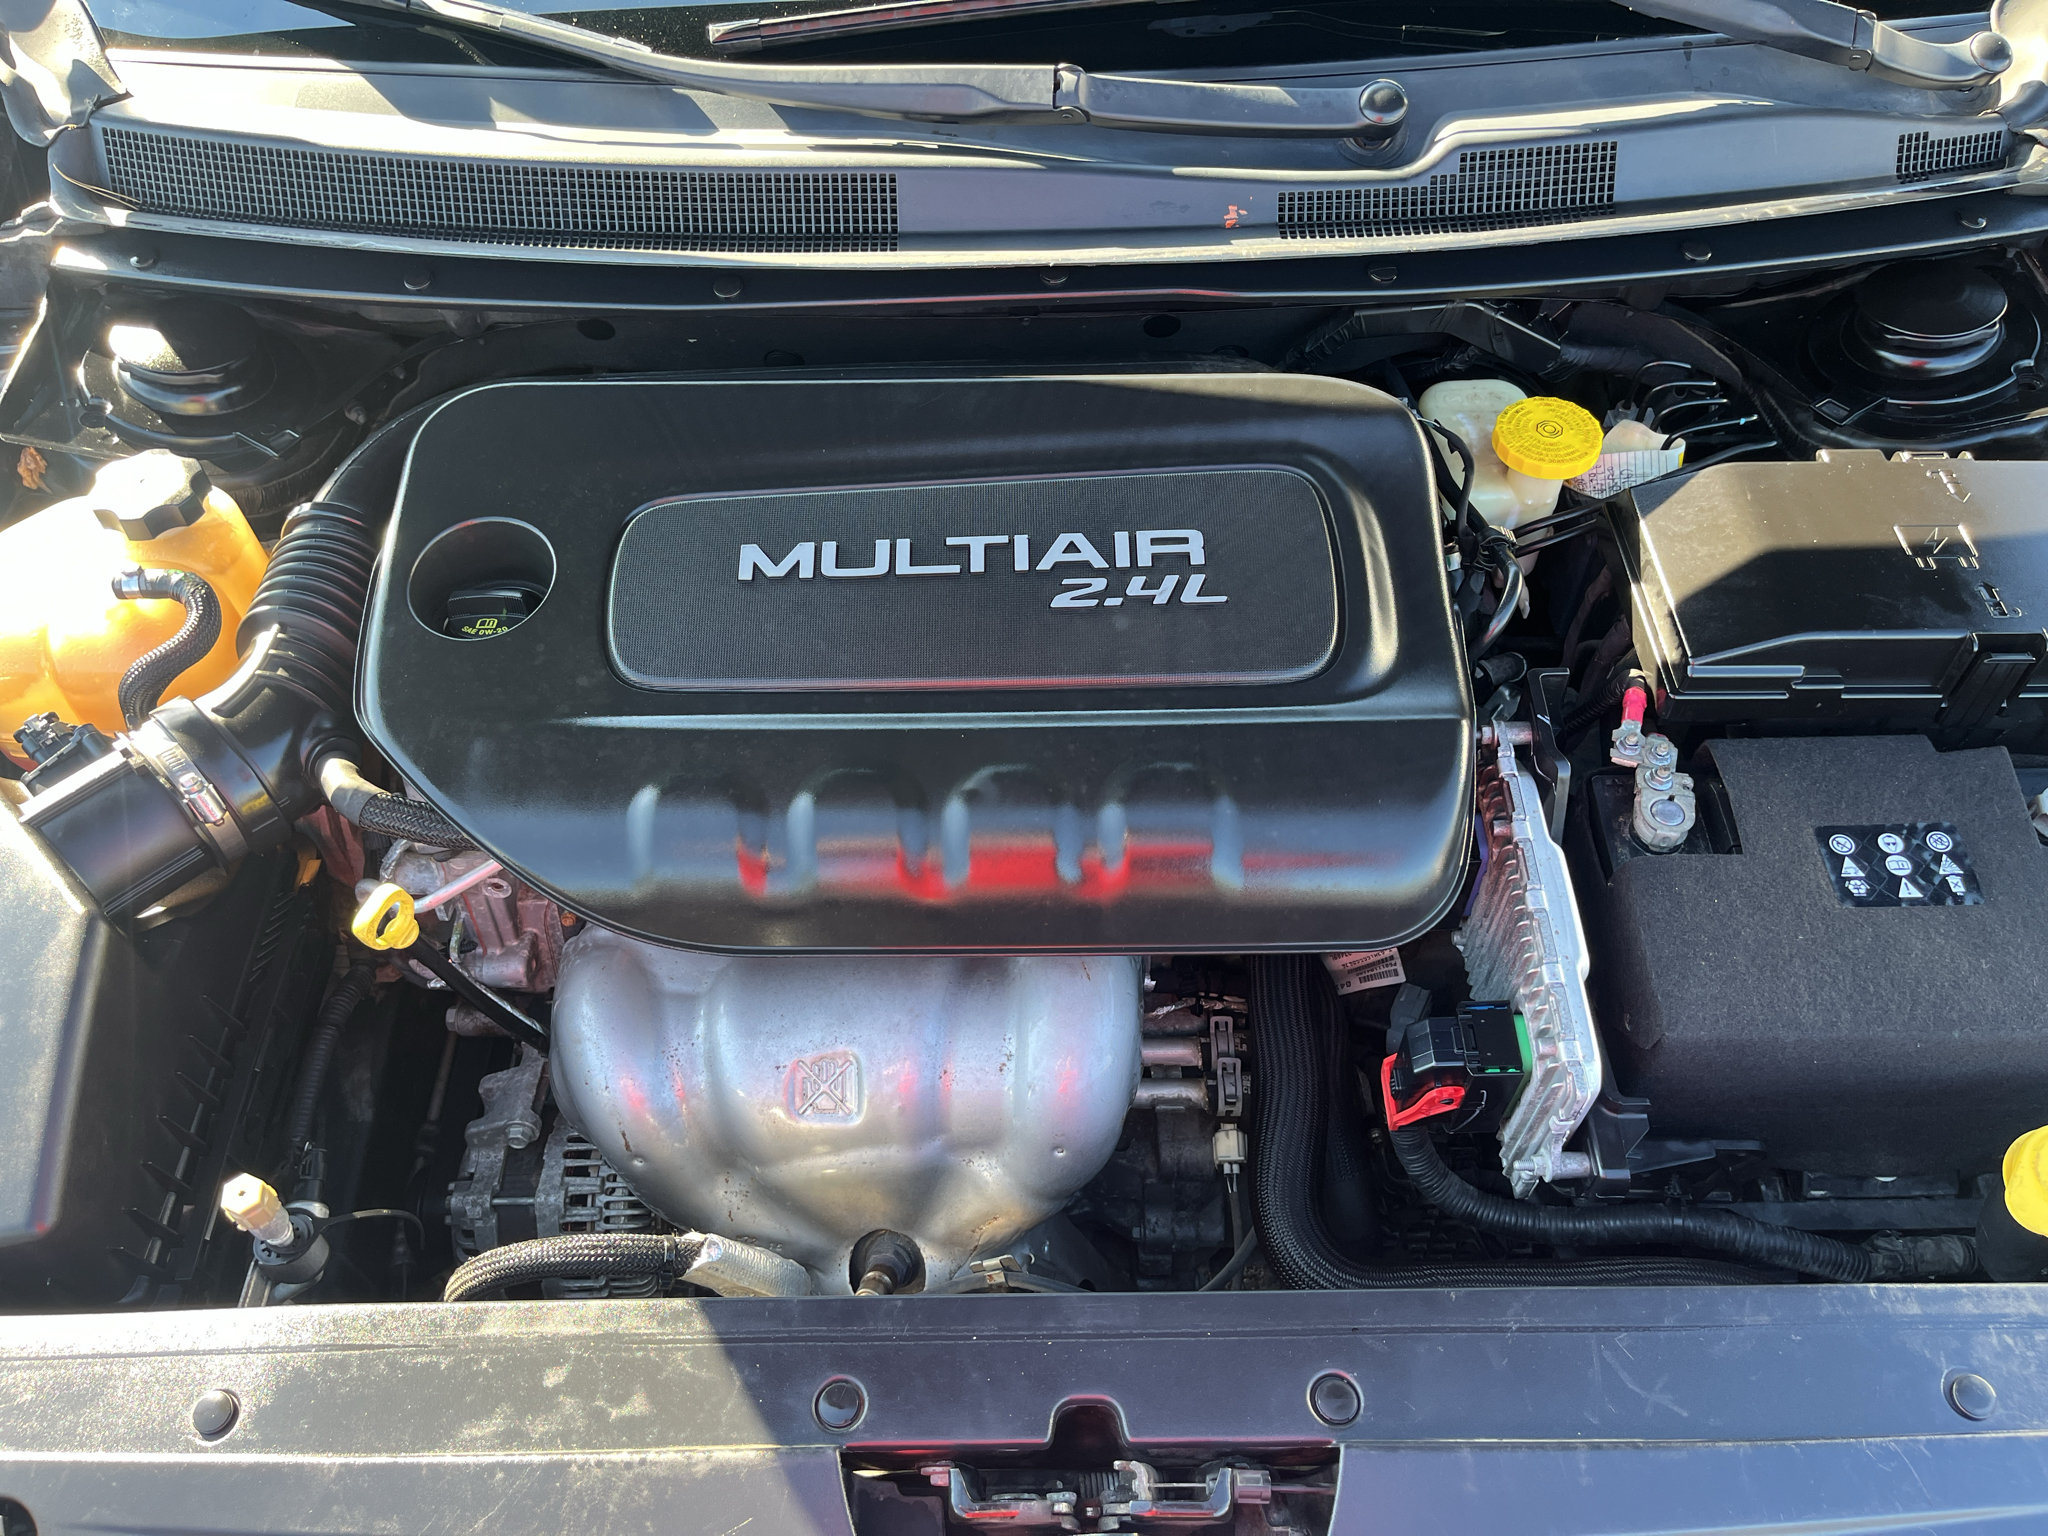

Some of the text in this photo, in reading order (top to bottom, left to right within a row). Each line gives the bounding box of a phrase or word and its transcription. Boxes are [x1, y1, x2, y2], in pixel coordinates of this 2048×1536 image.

[737, 528, 1205, 581] MULTIAIR
[1048, 574, 1228, 609] 2.4L
[461, 626, 478, 635] SAE
